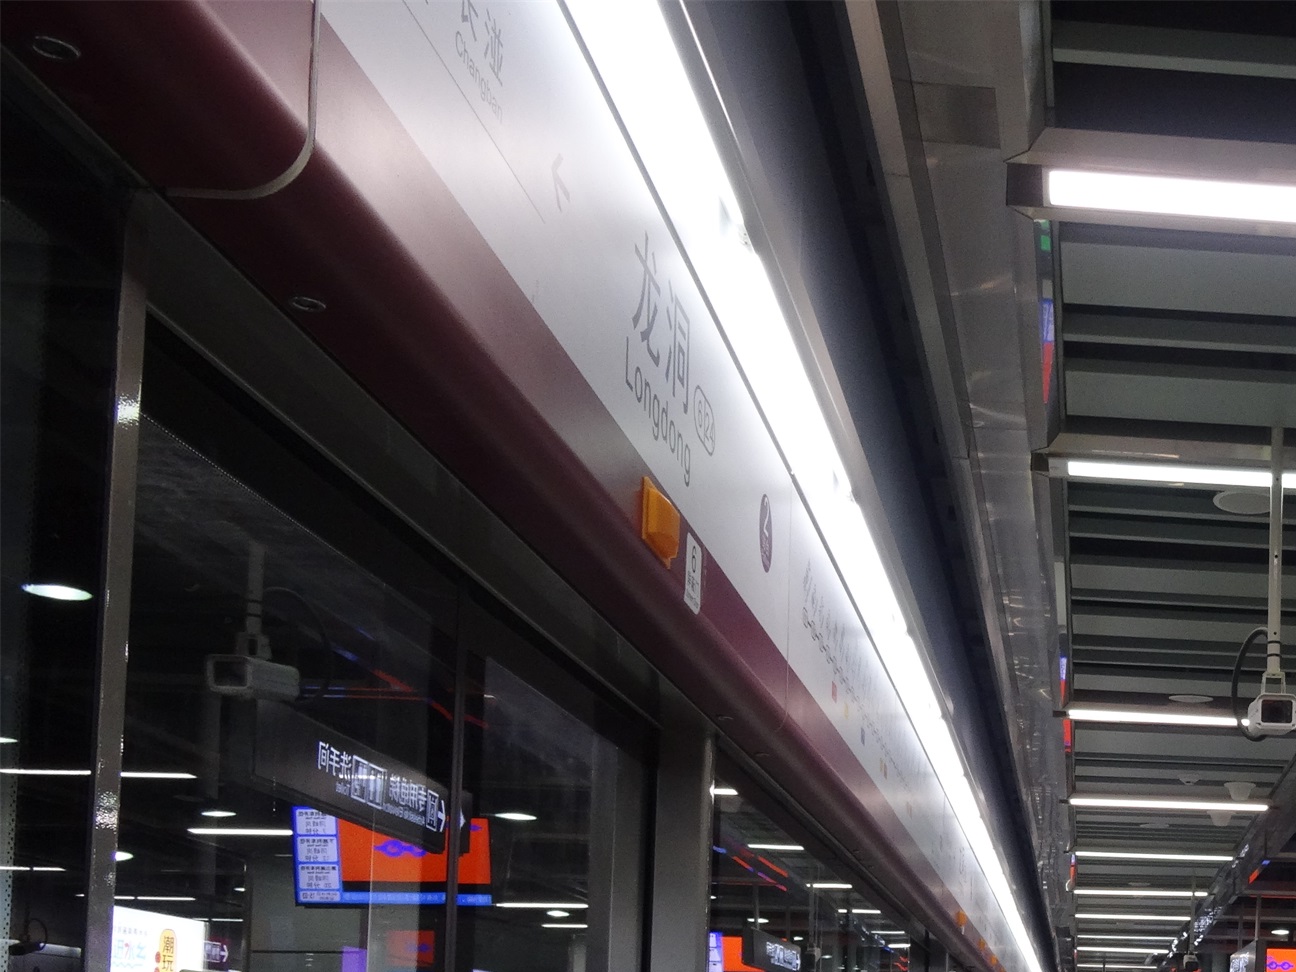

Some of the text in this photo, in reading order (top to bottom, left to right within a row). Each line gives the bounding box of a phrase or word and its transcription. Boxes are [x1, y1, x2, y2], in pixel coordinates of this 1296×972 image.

[455, 30, 502, 123] Changban
[632, 231, 691, 415] 龙洞
[625, 336, 691, 488] Longdong
[691, 545, 697, 573] 6
